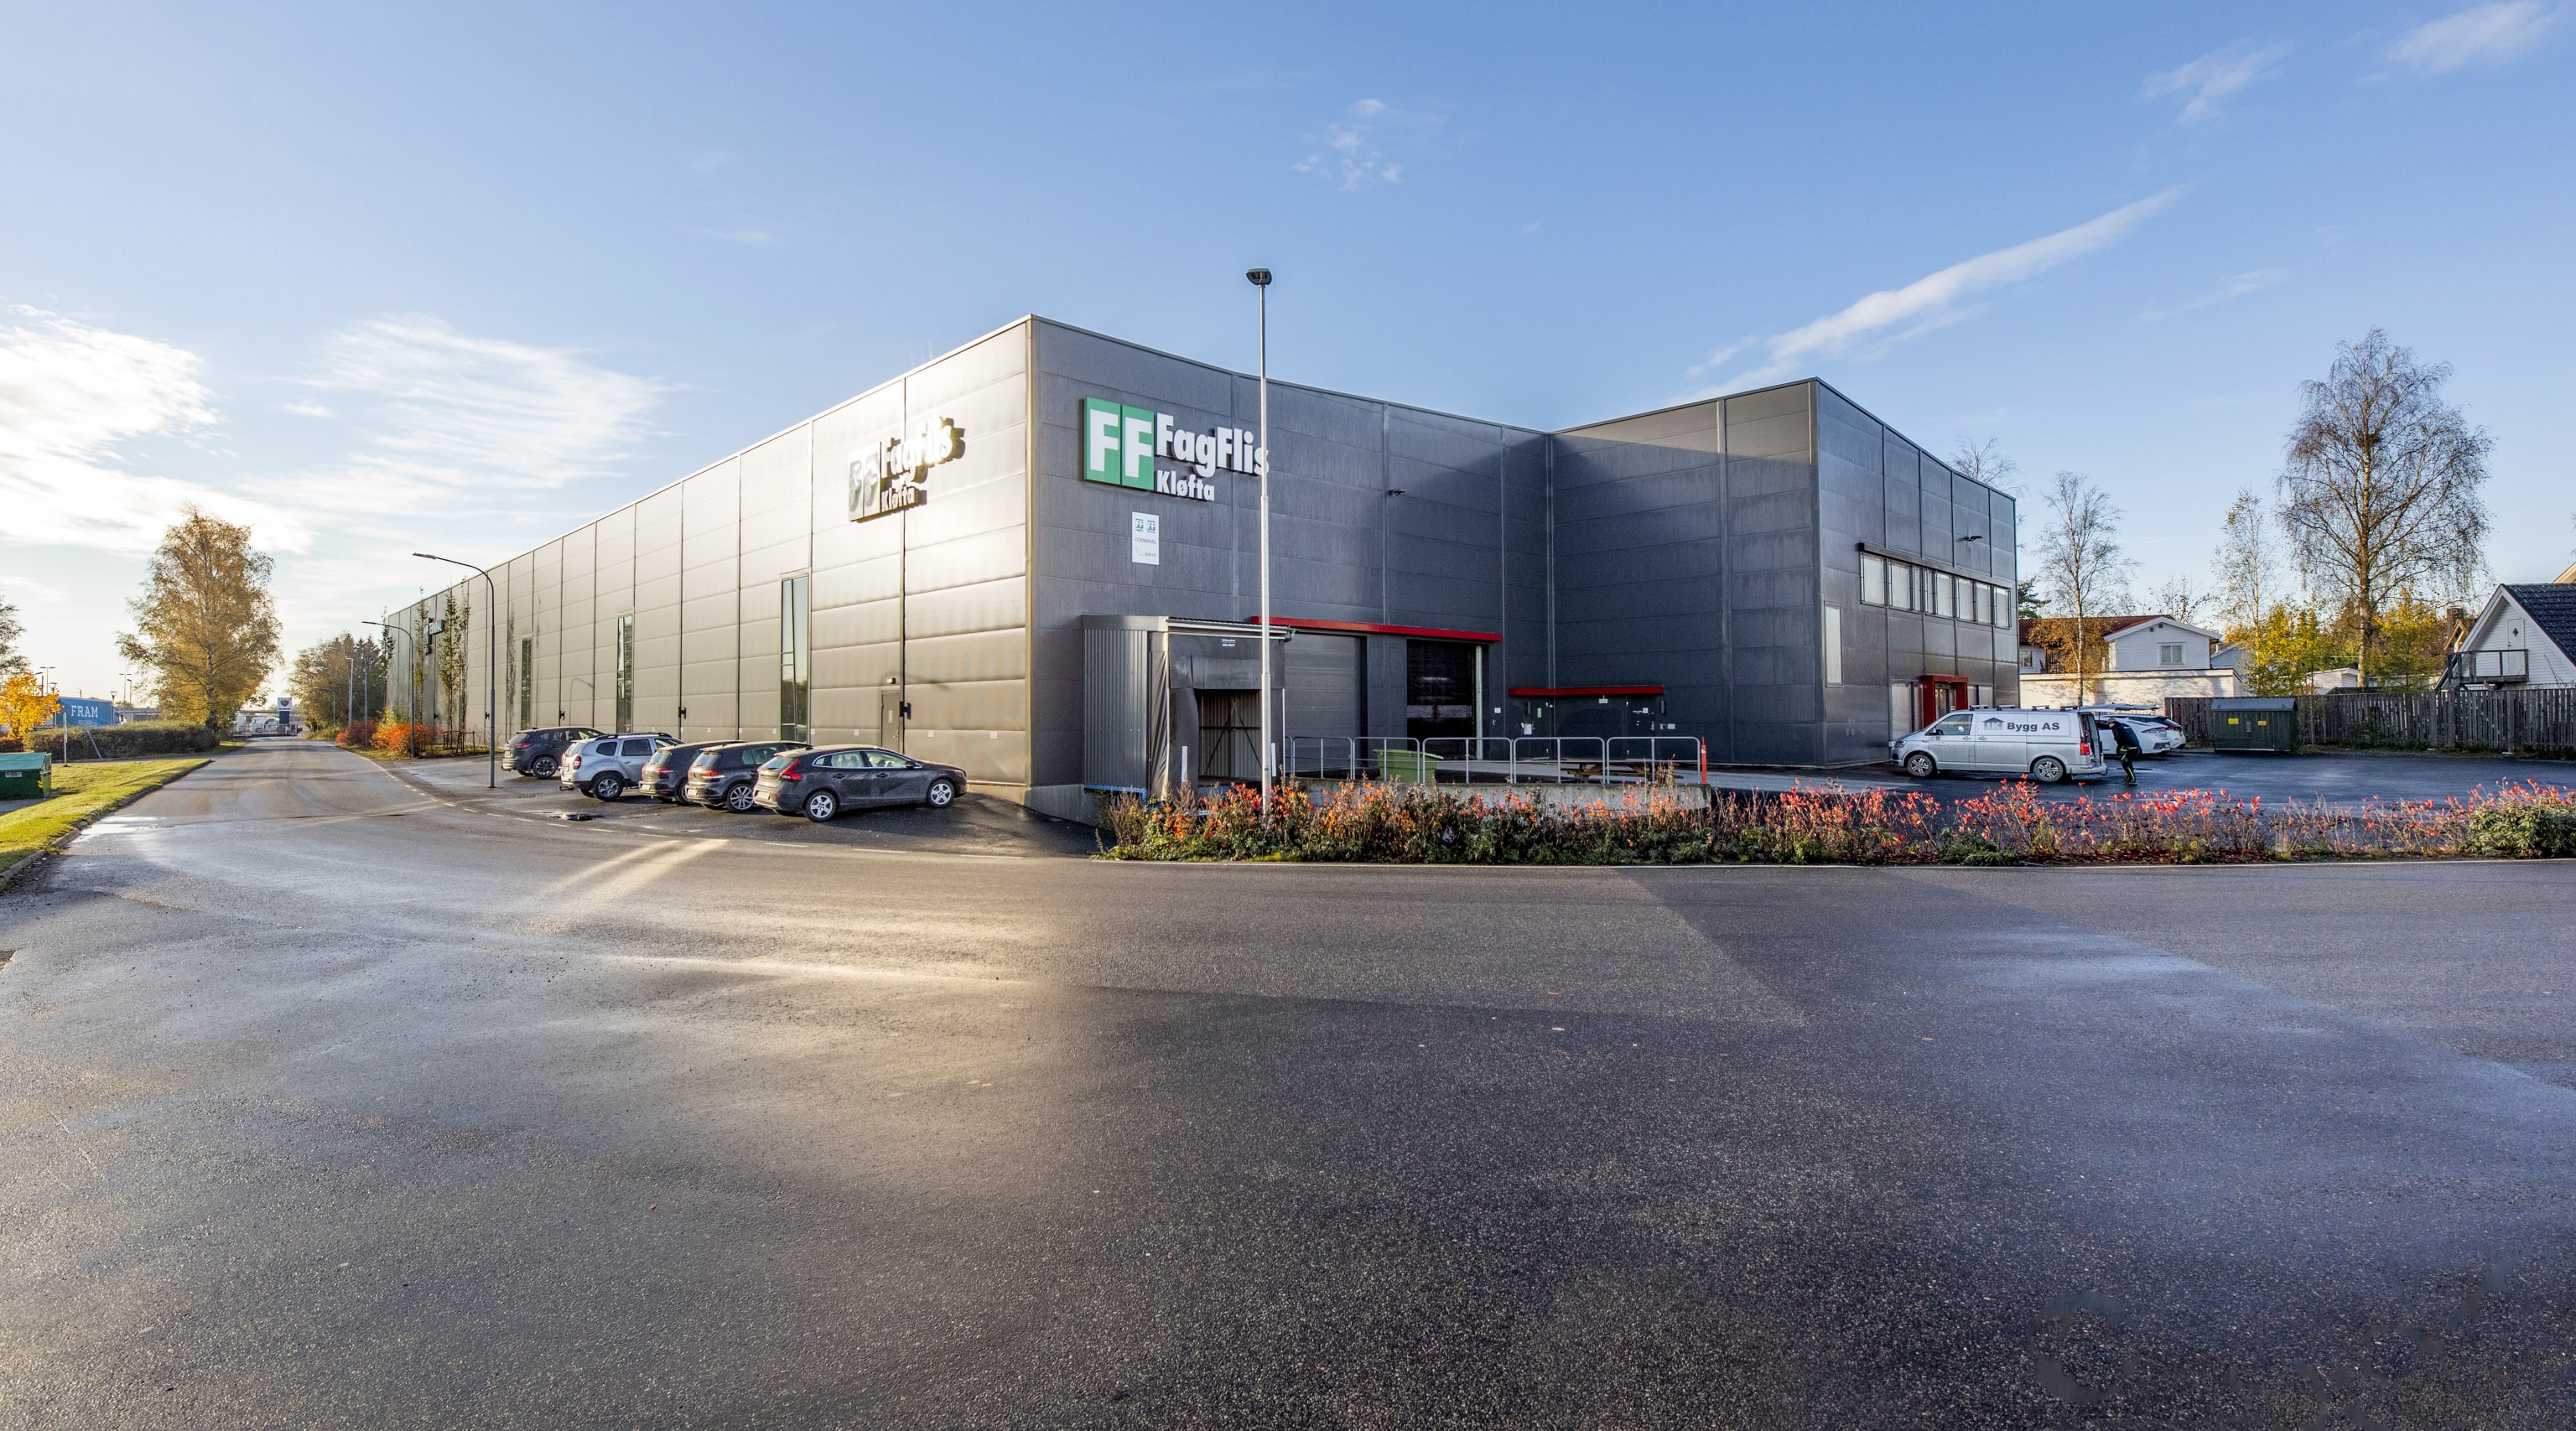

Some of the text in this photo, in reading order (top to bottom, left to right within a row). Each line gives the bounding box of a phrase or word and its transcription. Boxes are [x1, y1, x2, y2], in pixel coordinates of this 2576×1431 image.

[1090, 408, 1152, 479] FF
[1156, 412, 1270, 478] FagFlis
[881, 485, 916, 512] Kløfta
[1156, 469, 1215, 501] Kløfta
[1135, 537, 1156, 545] TERMINAL
[70, 705, 99, 718] FRAM
[2007, 722, 2038, 732] Bygg
[2042, 722, 2060, 730] AS
